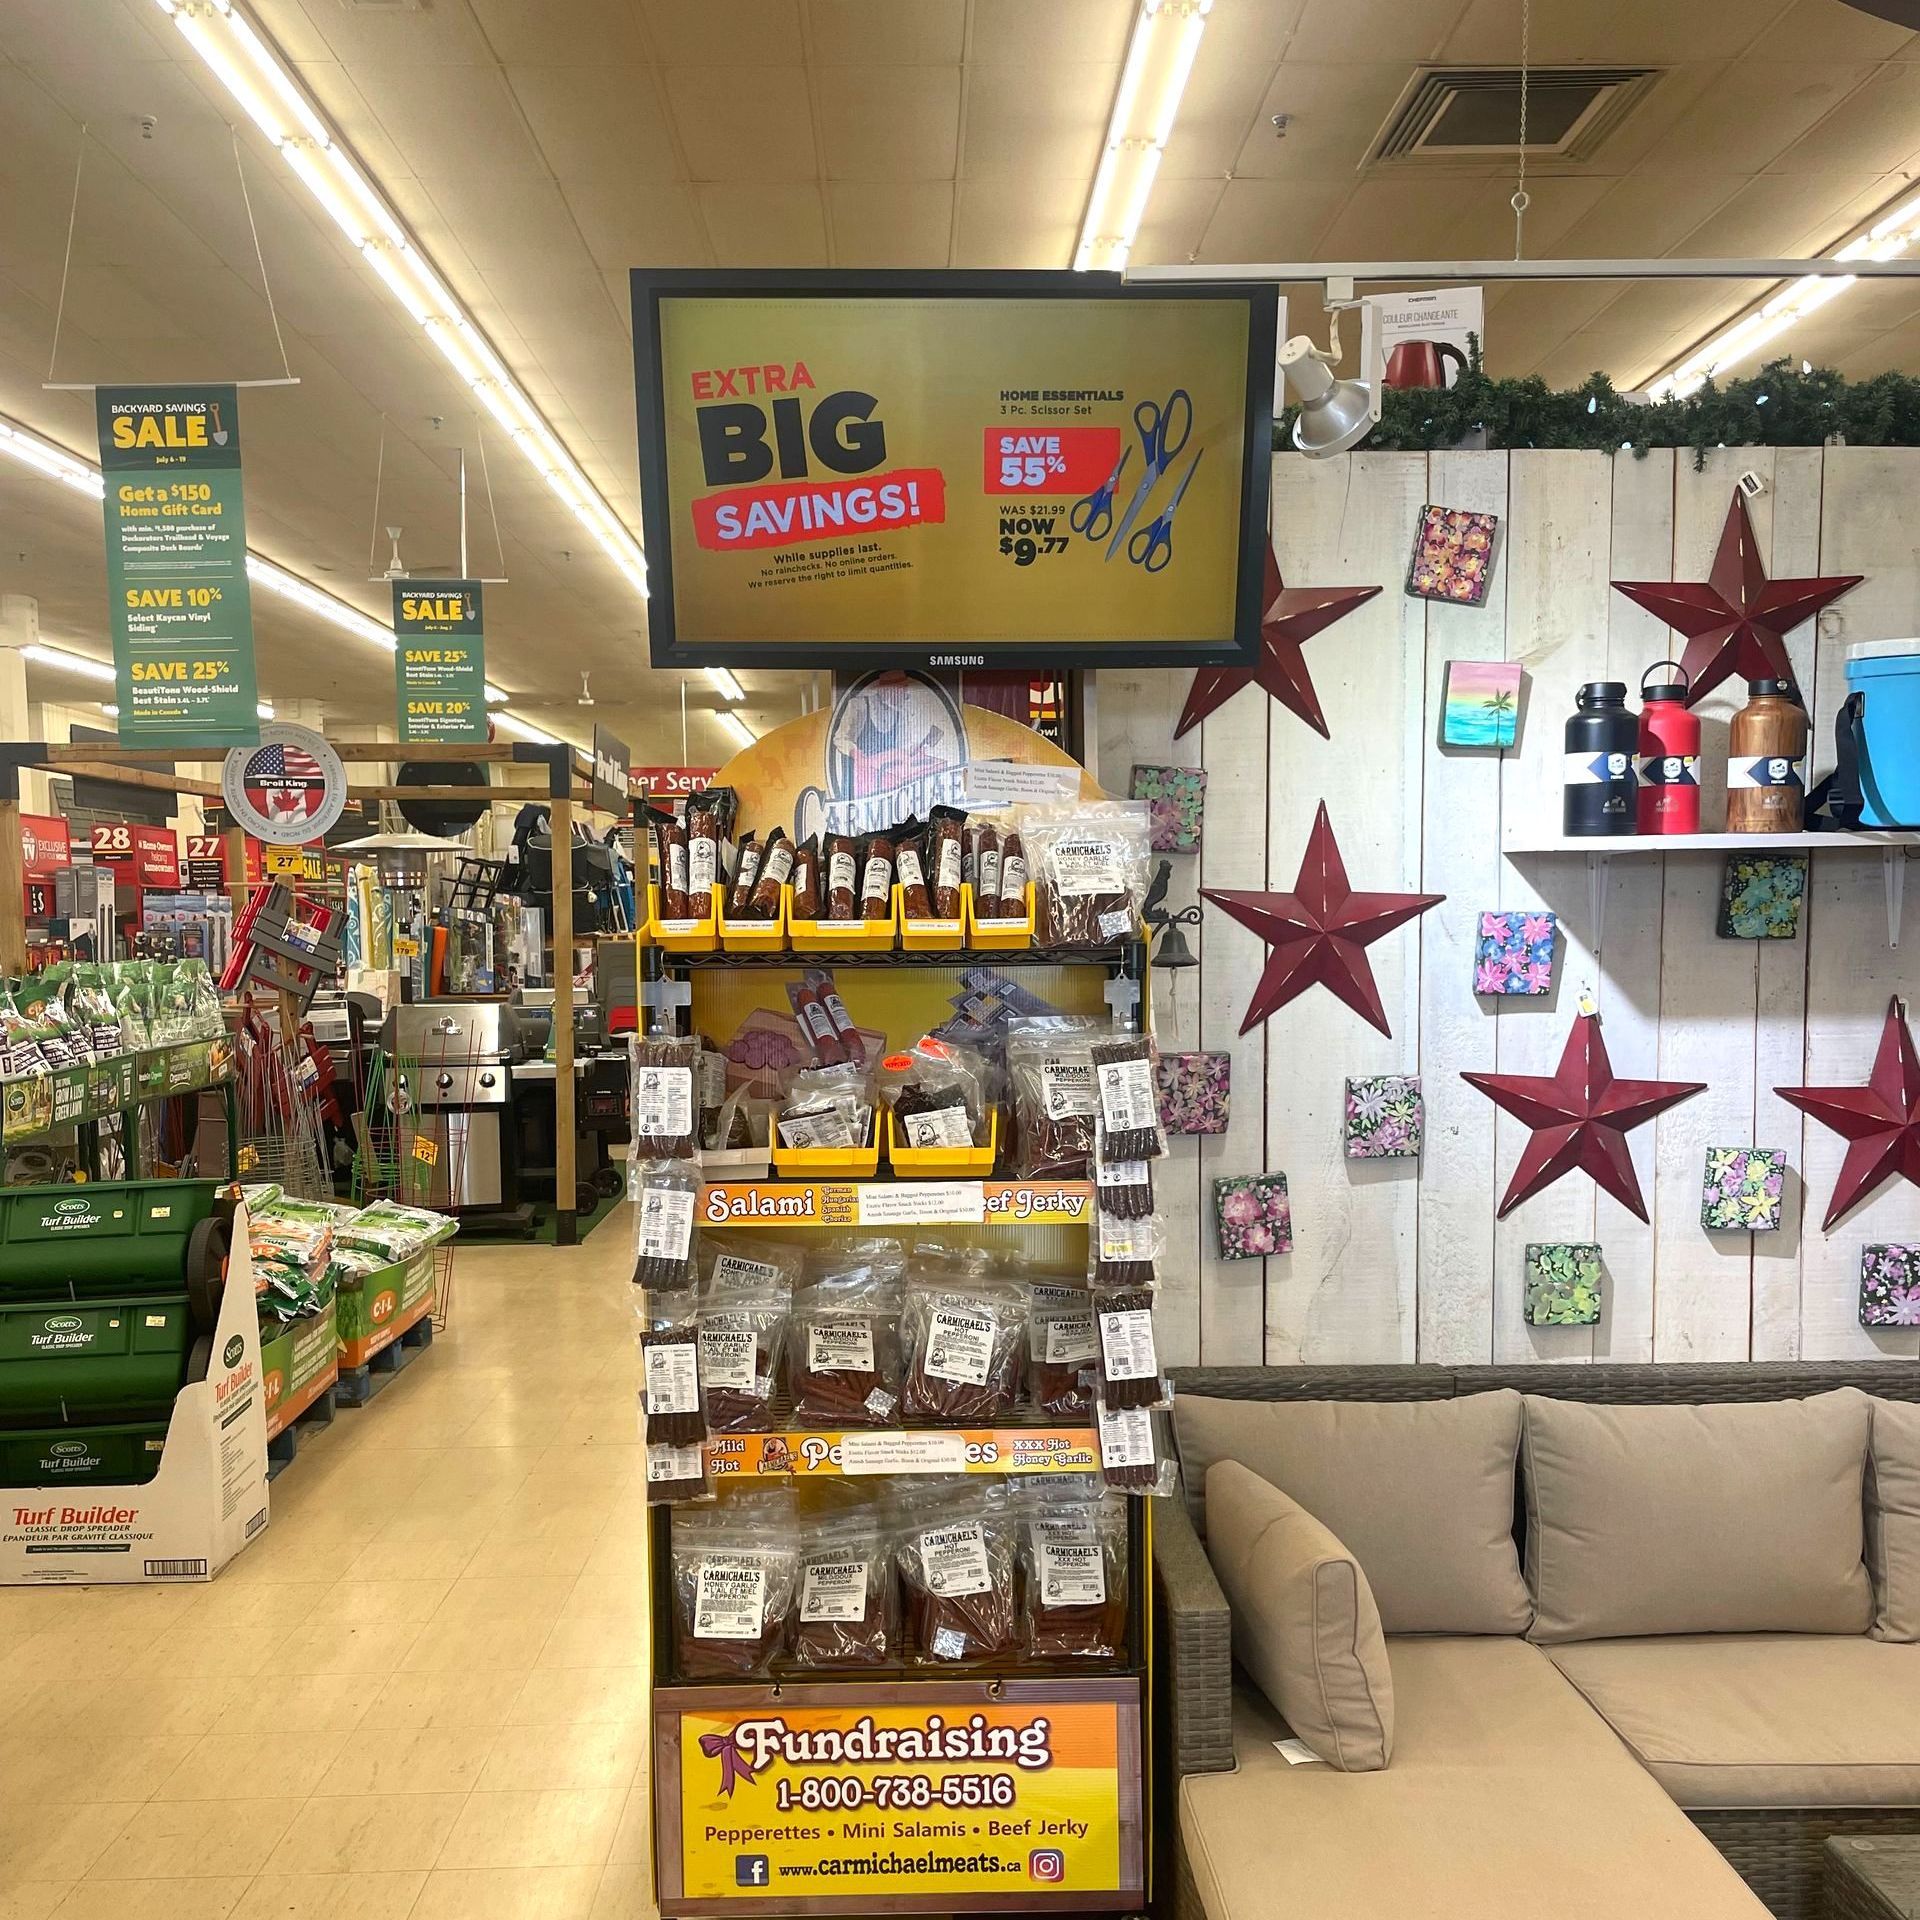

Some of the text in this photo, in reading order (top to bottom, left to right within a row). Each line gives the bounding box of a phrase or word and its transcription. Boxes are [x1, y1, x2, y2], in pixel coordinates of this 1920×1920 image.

[1383, 312, 1413, 325] COULEUR
[691, 361, 816, 400] EXTRA
[1000, 390, 1124, 401] HOME ESSENTIALS
[112, 403, 207, 414] BACKYARD SAVINGS
[1000, 405, 1092, 415] 3 Pc. Scissor Set
[112, 416, 208, 448] SALE
[696, 391, 887, 487] BIG
[1000, 437, 1060, 454] SAVE
[156, 456, 169, 464] July
[1000, 456, 1066, 487] 55%
[119, 484, 211, 502] Get a $150
[120, 502, 222, 517] Home Gift Card
[715, 481, 920, 540] SAVINGS!
[1000, 505, 1065, 516] WAS $21.99
[176, 524, 206, 533] purchase
[999, 518, 1055, 535] NOW
[773, 542, 882, 565] While supplies last.
[999, 537, 1069, 566] $9.77
[761, 553, 897, 577] No rainchecks. No online orders.
[764, 578, 796, 587] reserve
[798, 574, 812, 582] the
[814, 571, 834, 581] right
[848, 567, 867, 576] limit
[869, 561, 914, 574] quantities.
[126, 587, 222, 608] SAVE 10%
[402, 600, 463, 620] SALE
[127, 612, 211, 623] Select Kaycan Vinyl
[405, 650, 468, 663] SAVE 25%
[929, 655, 984, 666] SAMSUNG
[132, 661, 229, 681] SAVE 25%
[132, 684, 239, 695] BeautiTone Wood-Shield
[133, 695, 176, 704] Best Stain
[407, 702, 470, 714] SAVE 20%
[260, 779, 308, 789] Broil King
[94, 827, 131, 850] 28
[38, 840, 67, 853] EXCLUSIVE
[189, 837, 220, 857] 27
[1055, 844, 1112, 857] CARMICHAEL'S
[303, 858, 321, 880] SALE
[821, 1186, 852, 1195] German
[59, 1203, 85, 1211] Scotts
[706, 1189, 815, 1222] Salami
[1015, 1188, 1087, 1218] Jerky
[821, 1205, 851, 1214] Spanish
[41, 1215, 102, 1226] Turf Builder
[821, 1215, 852, 1223] Chorizo
[721, 1257, 774, 1278] CARMICHAEL'S
[50, 1320, 77, 1328] Scotts
[936, 1313, 991, 1332] CARMICHAEL'S
[31, 1333, 94, 1345] Turf Builder
[813, 1328, 868, 1339] CARMICHAEL'S
[943, 1329, 980, 1342] PEPPERONI
[225, 1341, 243, 1362] Scotts
[215, 1377, 230, 1403] Turf
[230, 1361, 253, 1393] Builder
[55, 1445, 82, 1454] Scotts
[710, 1439, 745, 1454] Mild
[1047, 1438, 1071, 1451] Hot
[40, 1457, 101, 1469] Turf Builder
[1013, 1452, 1092, 1466] Honey Garlic
[710, 1460, 739, 1474] Hot
[13, 1506, 139, 1525] Turf Builder
[25, 1525, 58, 1533] CLASSIC
[87, 1524, 131, 1532] SPREADER
[3, 1534, 49, 1542] ÉPANDEUR
[71, 1532, 107, 1540] GRAVITÉ
[108, 1532, 154, 1541] CLASSIQUE
[924, 1530, 978, 1547] CARMICHAEL'S
[934, 1547, 971, 1557] PEPPERONI
[1045, 1546, 1099, 1557] CARMICHAEL'S
[703, 1570, 760, 1582] CARMICHAEL'S
[809, 1564, 863, 1576] CARMICHAEL'S
[704, 1581, 758, 1589] HONEY GARLIC
[735, 1716, 1051, 1770] Fundraising
[777, 1777, 1013, 1809] 1-800-738-5516
[705, 1819, 1089, 1845] Pepperettes Mini Salamis Beef Jerky
[779, 1850, 1021, 1876] www.carmichaelmeats.ca
